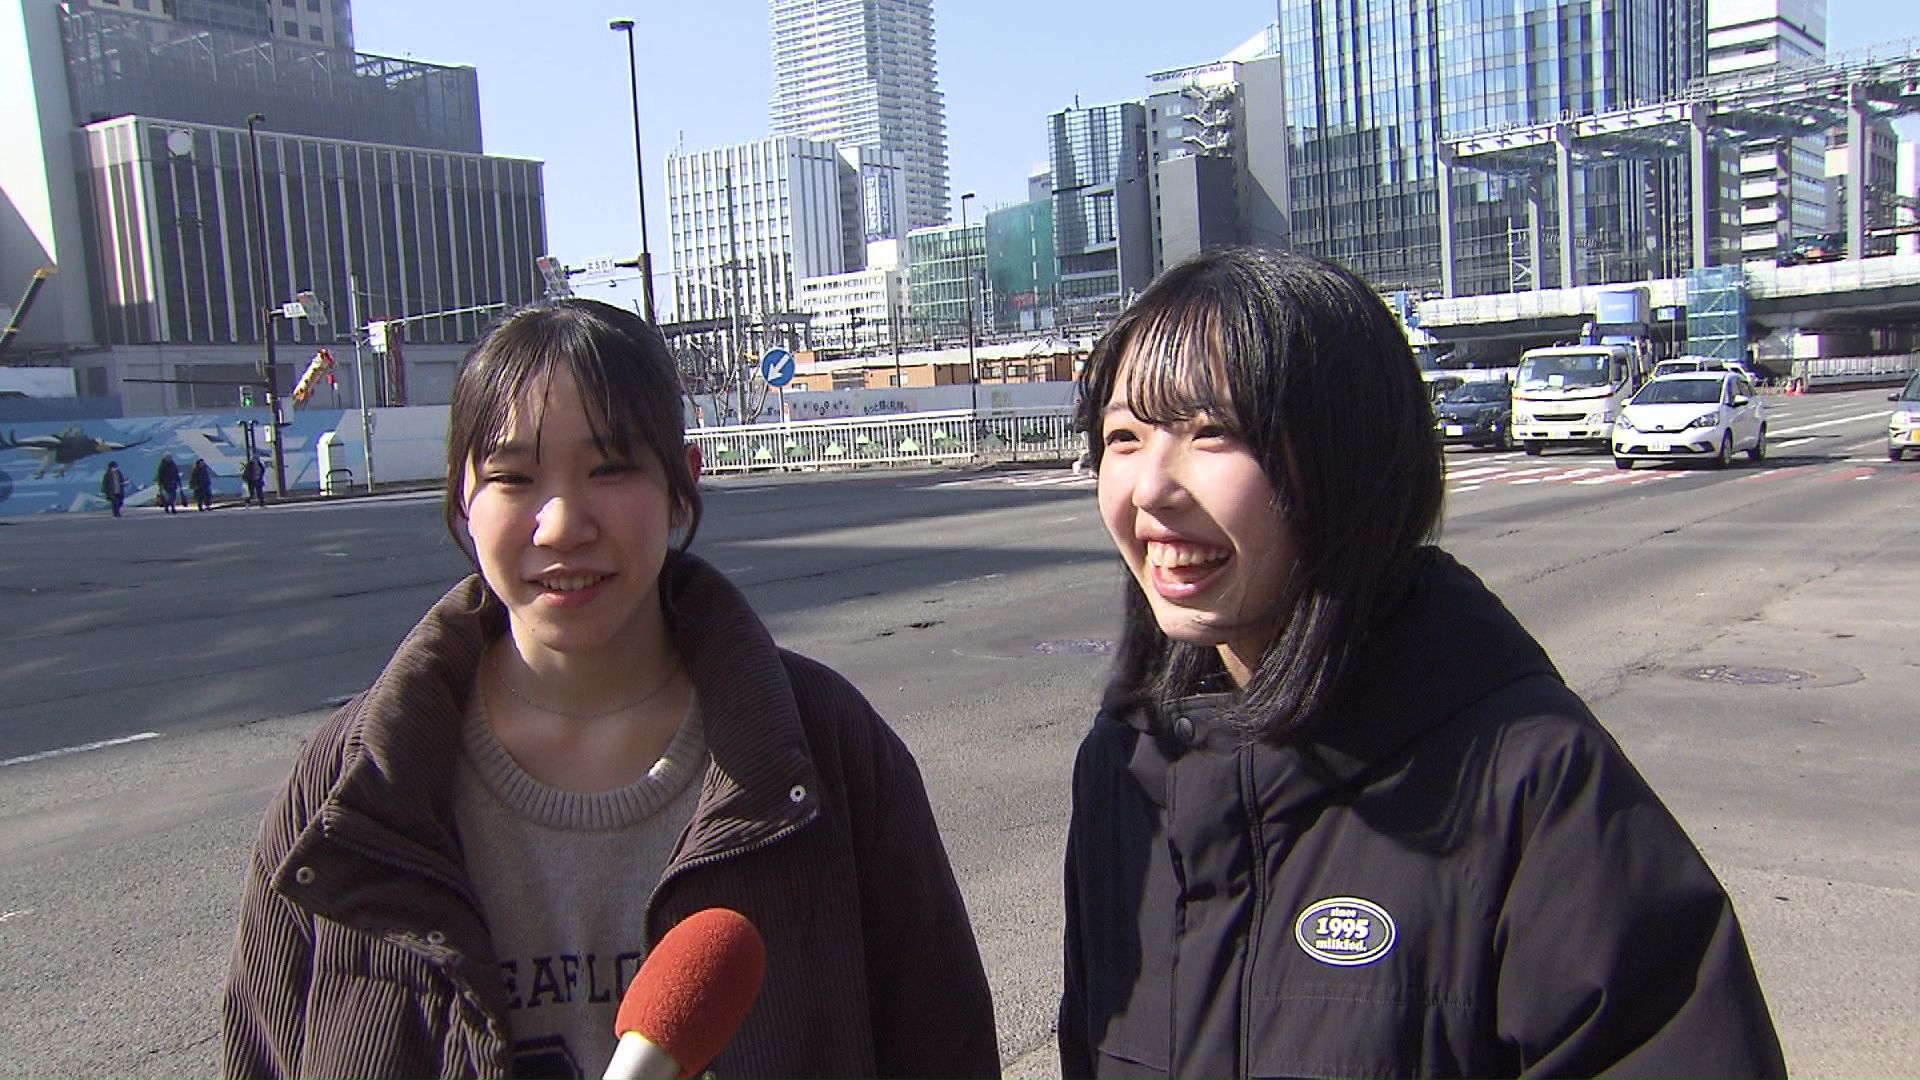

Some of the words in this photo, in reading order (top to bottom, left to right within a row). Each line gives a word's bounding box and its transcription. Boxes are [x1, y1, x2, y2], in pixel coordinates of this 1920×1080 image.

[1330, 907, 1357, 918] since
[1316, 917, 1369, 939] 1995
[1315, 938, 1368, 951] milkfed.
